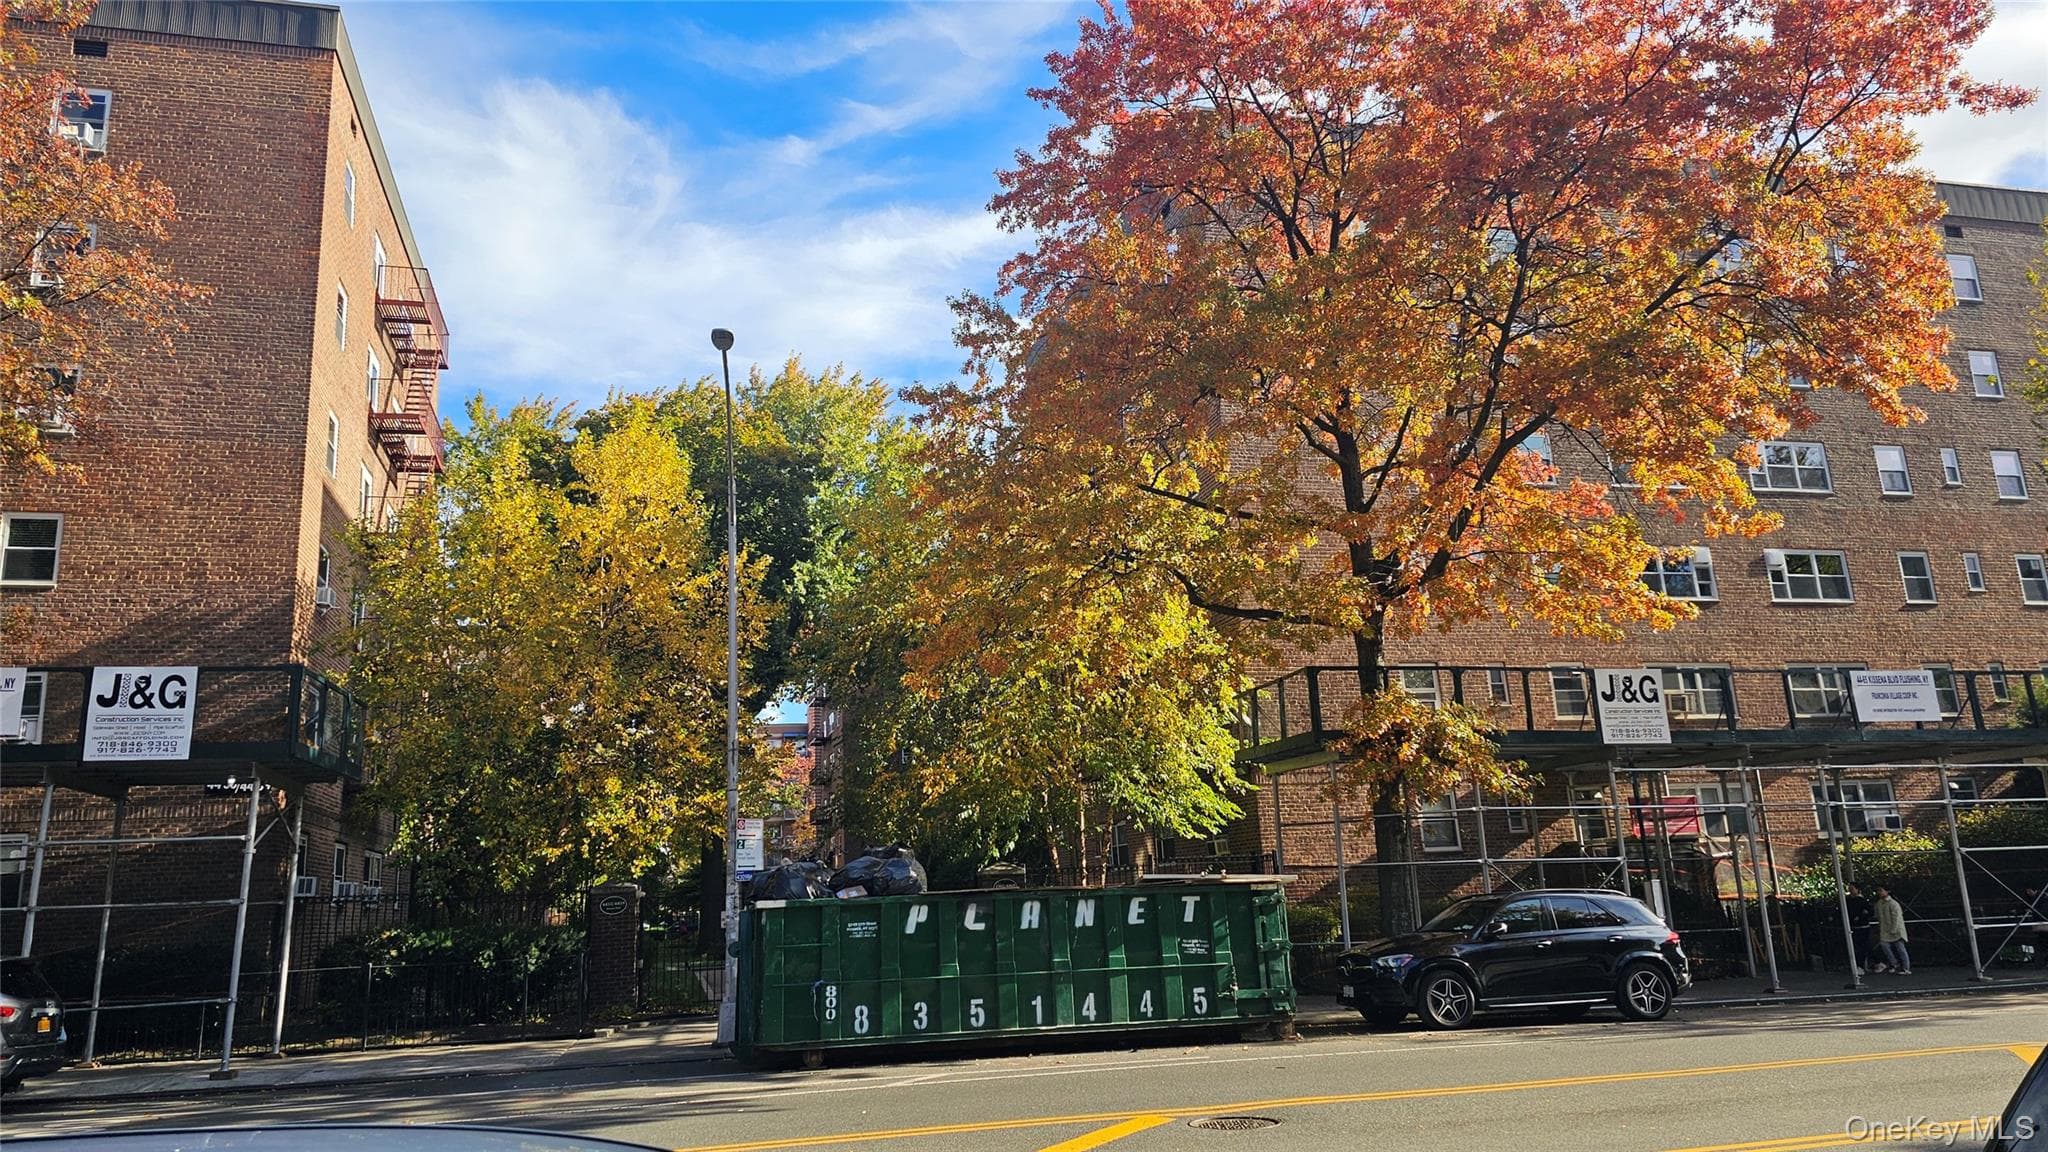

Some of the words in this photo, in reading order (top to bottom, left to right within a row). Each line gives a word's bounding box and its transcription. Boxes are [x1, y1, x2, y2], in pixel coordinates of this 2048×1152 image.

[4, 677, 16, 689] NY
[1868, 675, 1886, 684] KISSENA
[1887, 675, 1899, 684] BLVD
[1922, 675, 1929, 683] NY
[96, 673, 187, 709] J&G
[1601, 674, 1659, 703] J&G
[97, 740, 178, 748] 718-846-9300
